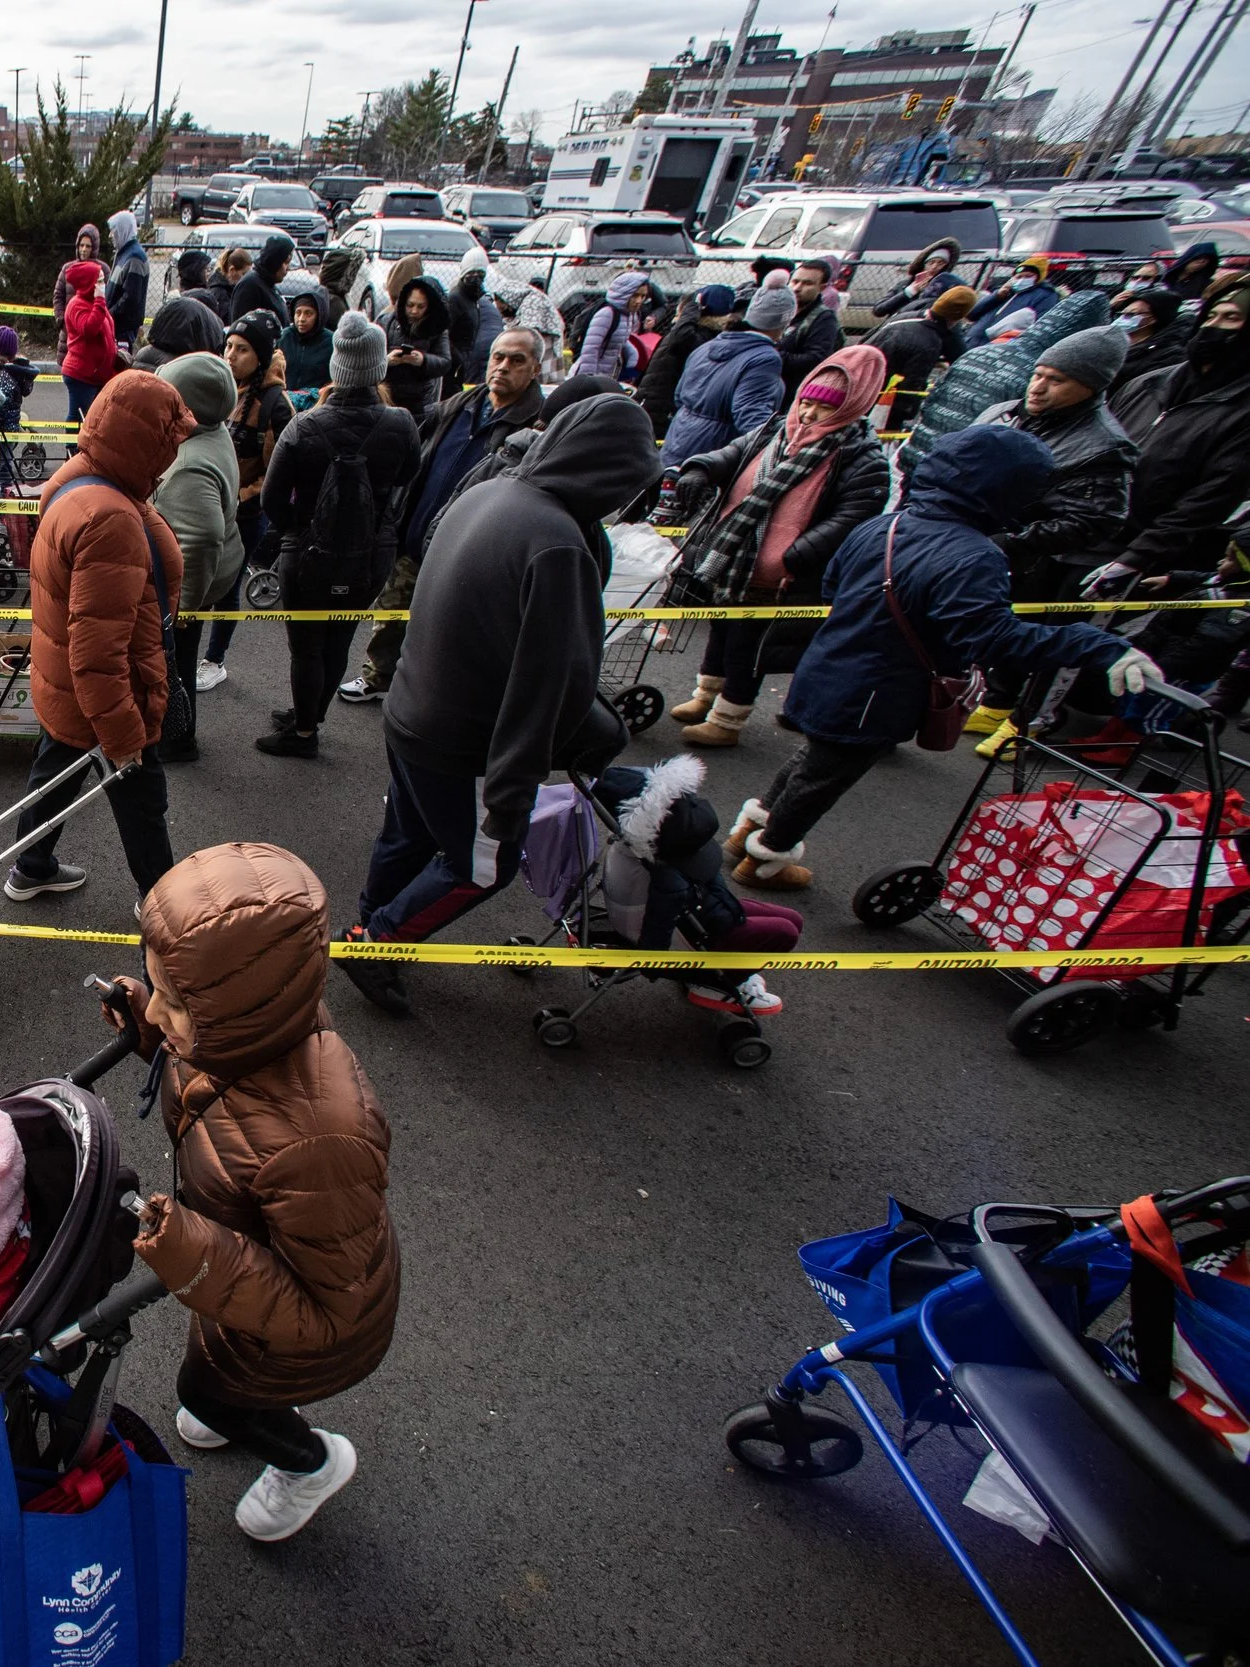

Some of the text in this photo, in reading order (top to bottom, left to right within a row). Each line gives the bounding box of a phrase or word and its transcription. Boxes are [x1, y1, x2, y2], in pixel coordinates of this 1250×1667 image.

[18, 501, 38, 512] CAUT
[42, 1568, 122, 1608] Lynn Community
[54, 1630, 78, 1638] cca
